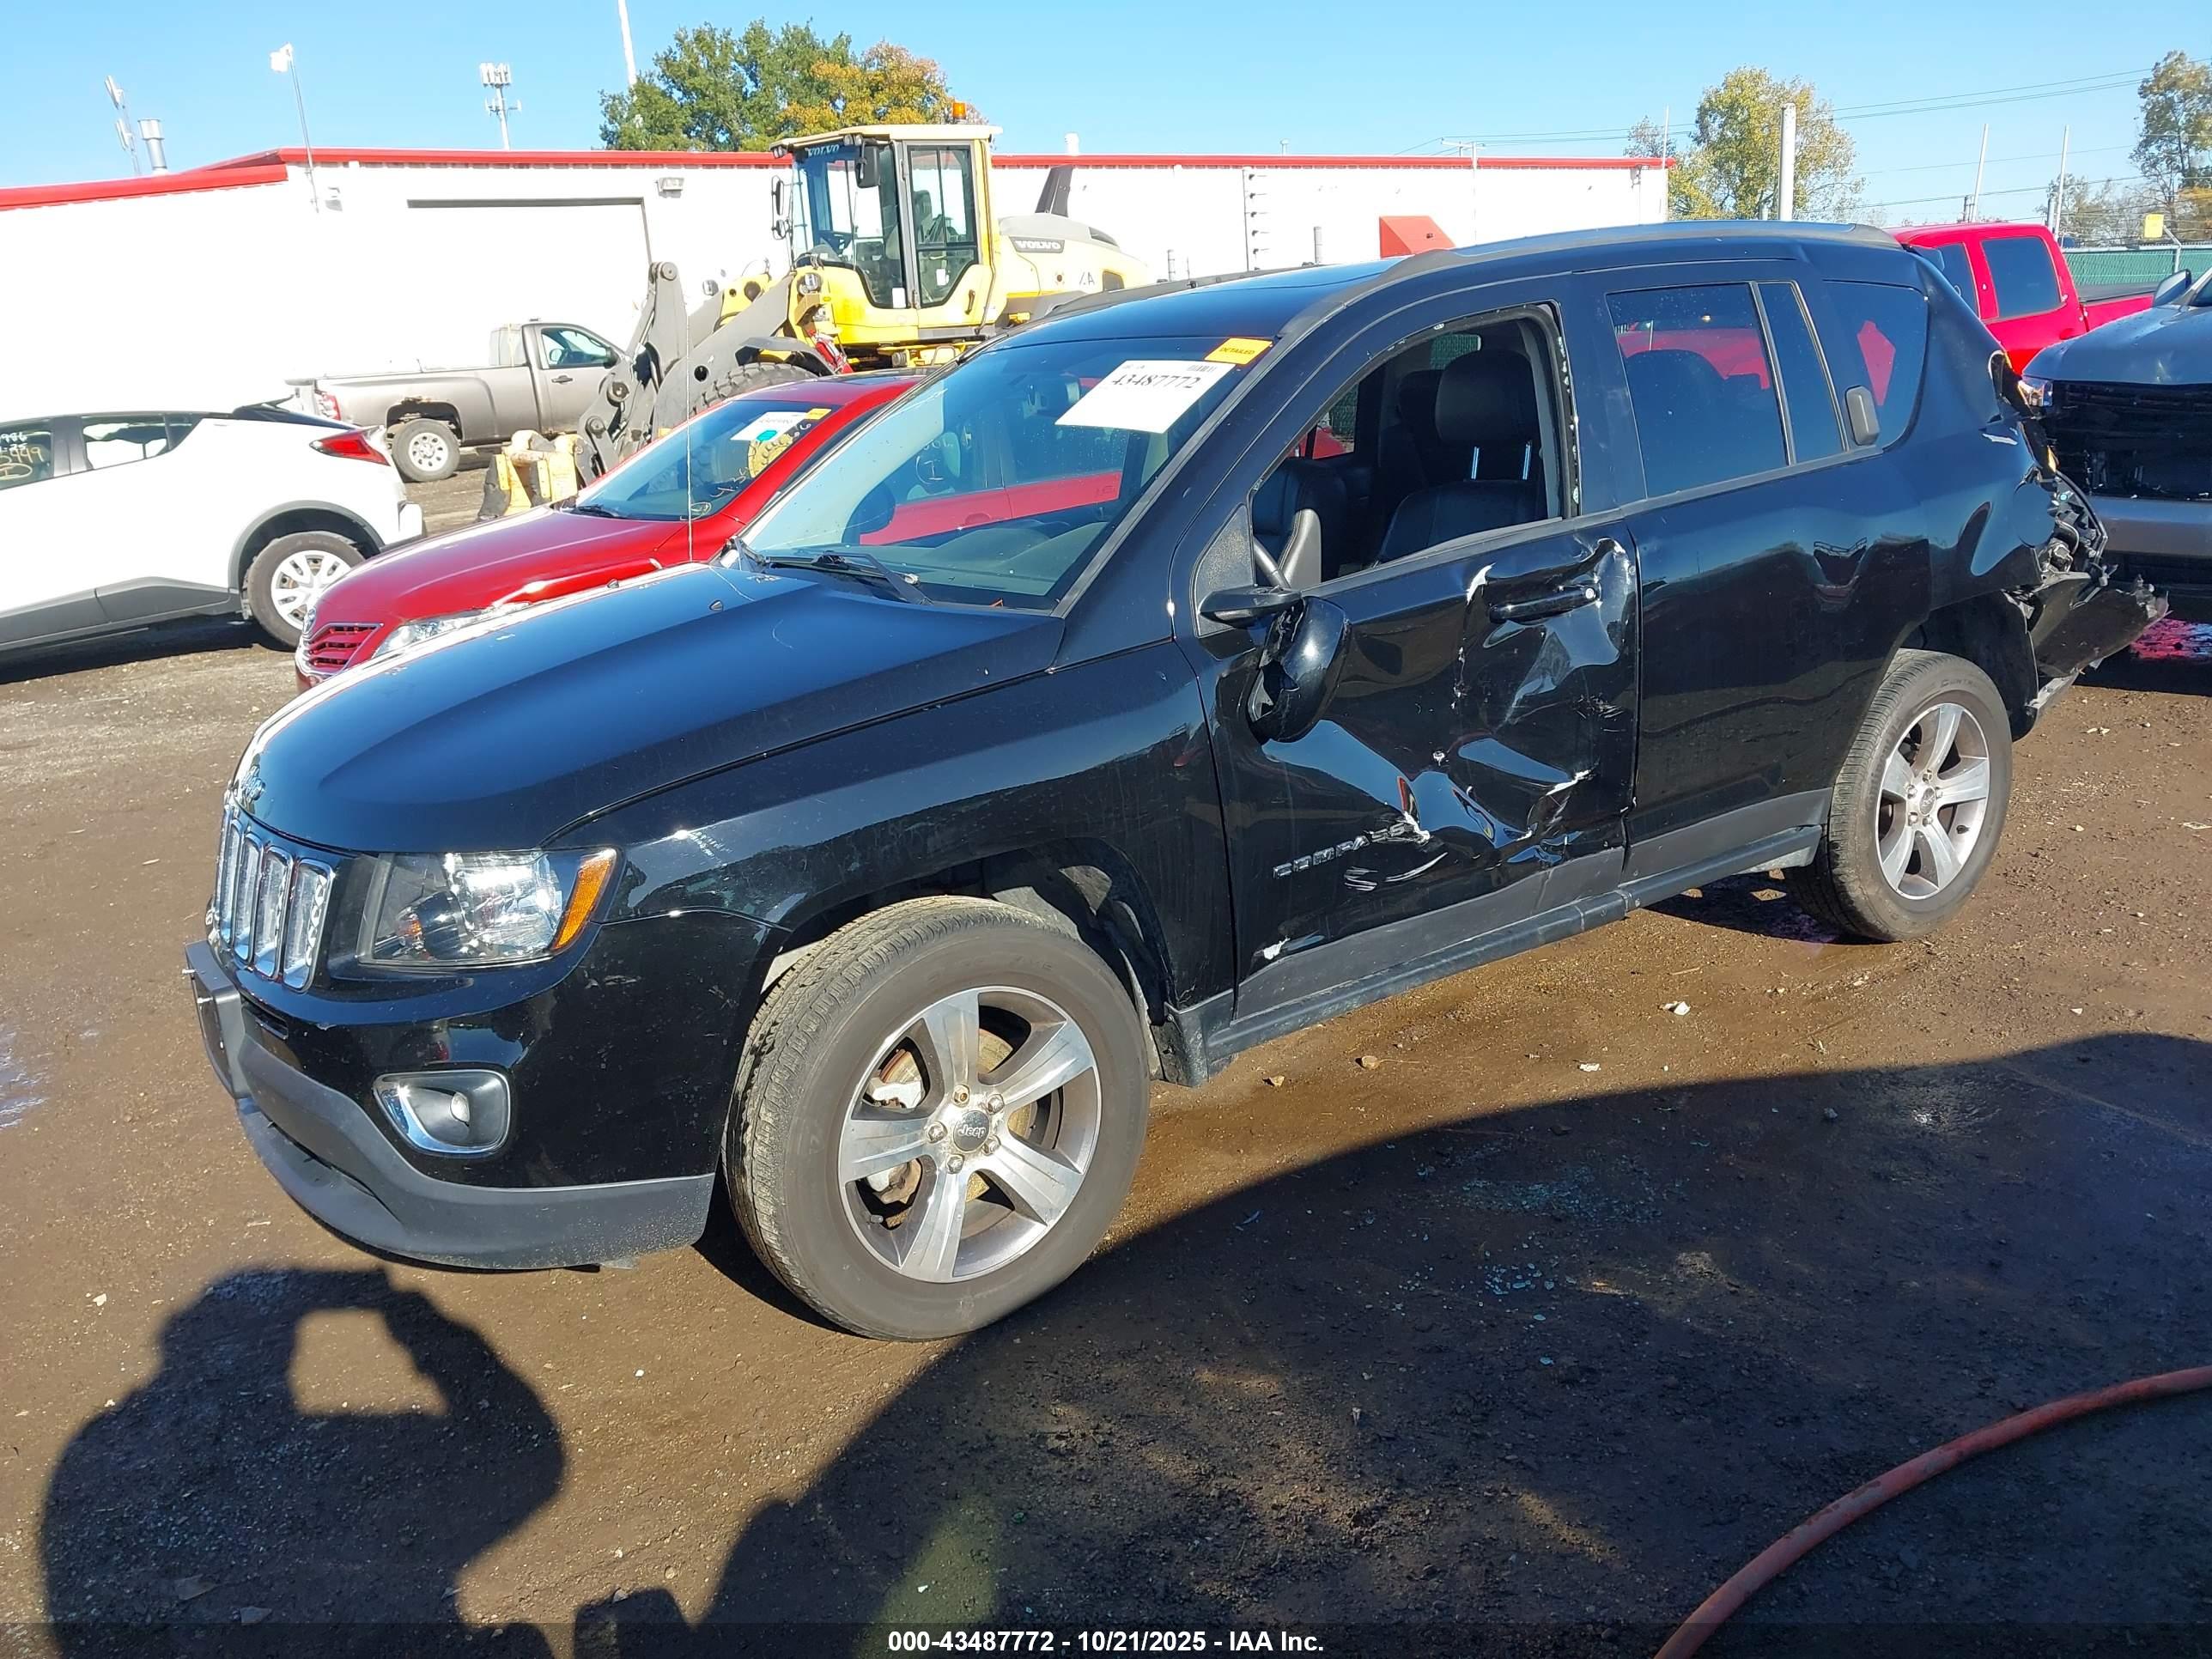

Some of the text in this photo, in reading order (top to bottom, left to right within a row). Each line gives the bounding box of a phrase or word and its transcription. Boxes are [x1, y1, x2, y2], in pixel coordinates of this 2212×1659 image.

[804, 143, 840, 157] VOLVO
[1014, 240, 1061, 250] VOLVO
[1112, 374, 1201, 389] 43487772
[958, 1123, 987, 1139] Jeep
